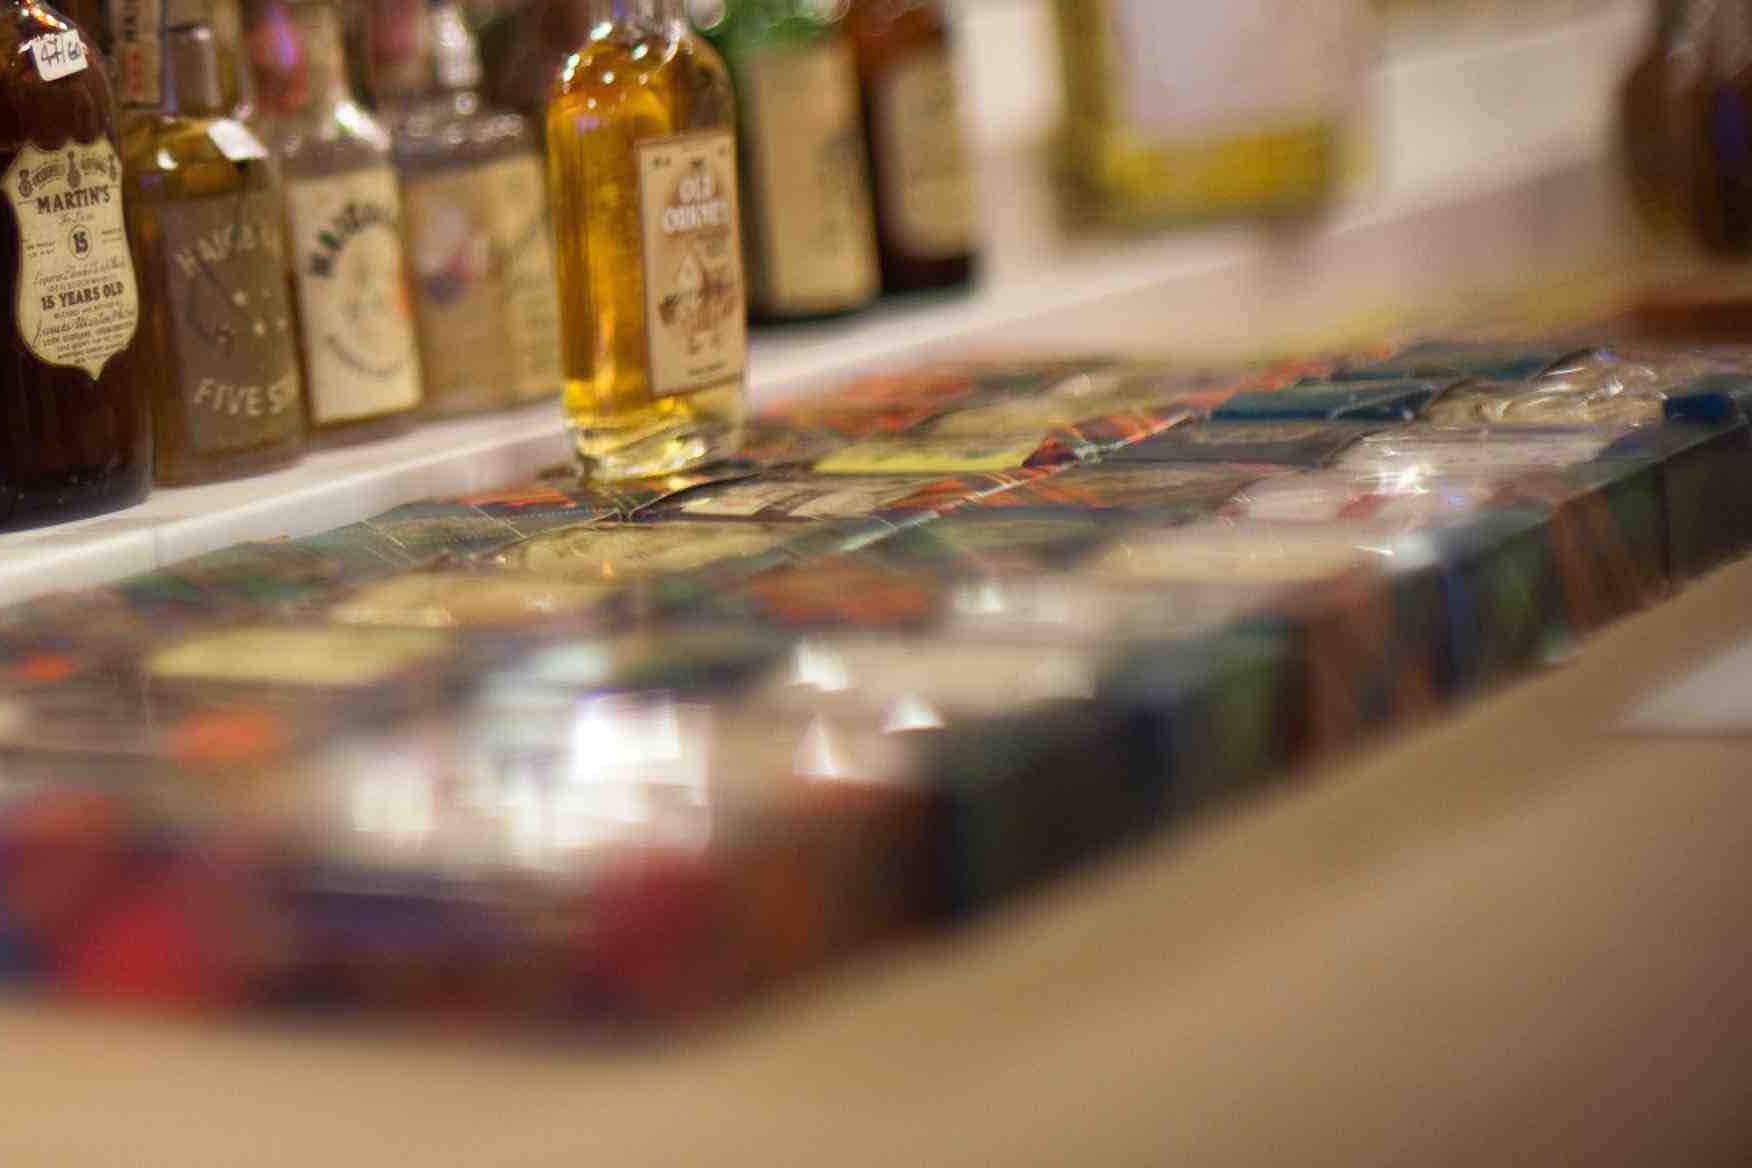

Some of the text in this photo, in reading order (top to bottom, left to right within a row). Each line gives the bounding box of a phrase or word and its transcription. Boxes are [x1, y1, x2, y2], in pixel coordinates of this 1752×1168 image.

[36, 184, 111, 216] MARTIN'S
[72, 230, 90, 253] 15
[41, 295, 56, 311] 15
[59, 287, 101, 308] YEARS
[102, 281, 124, 299] OLD
